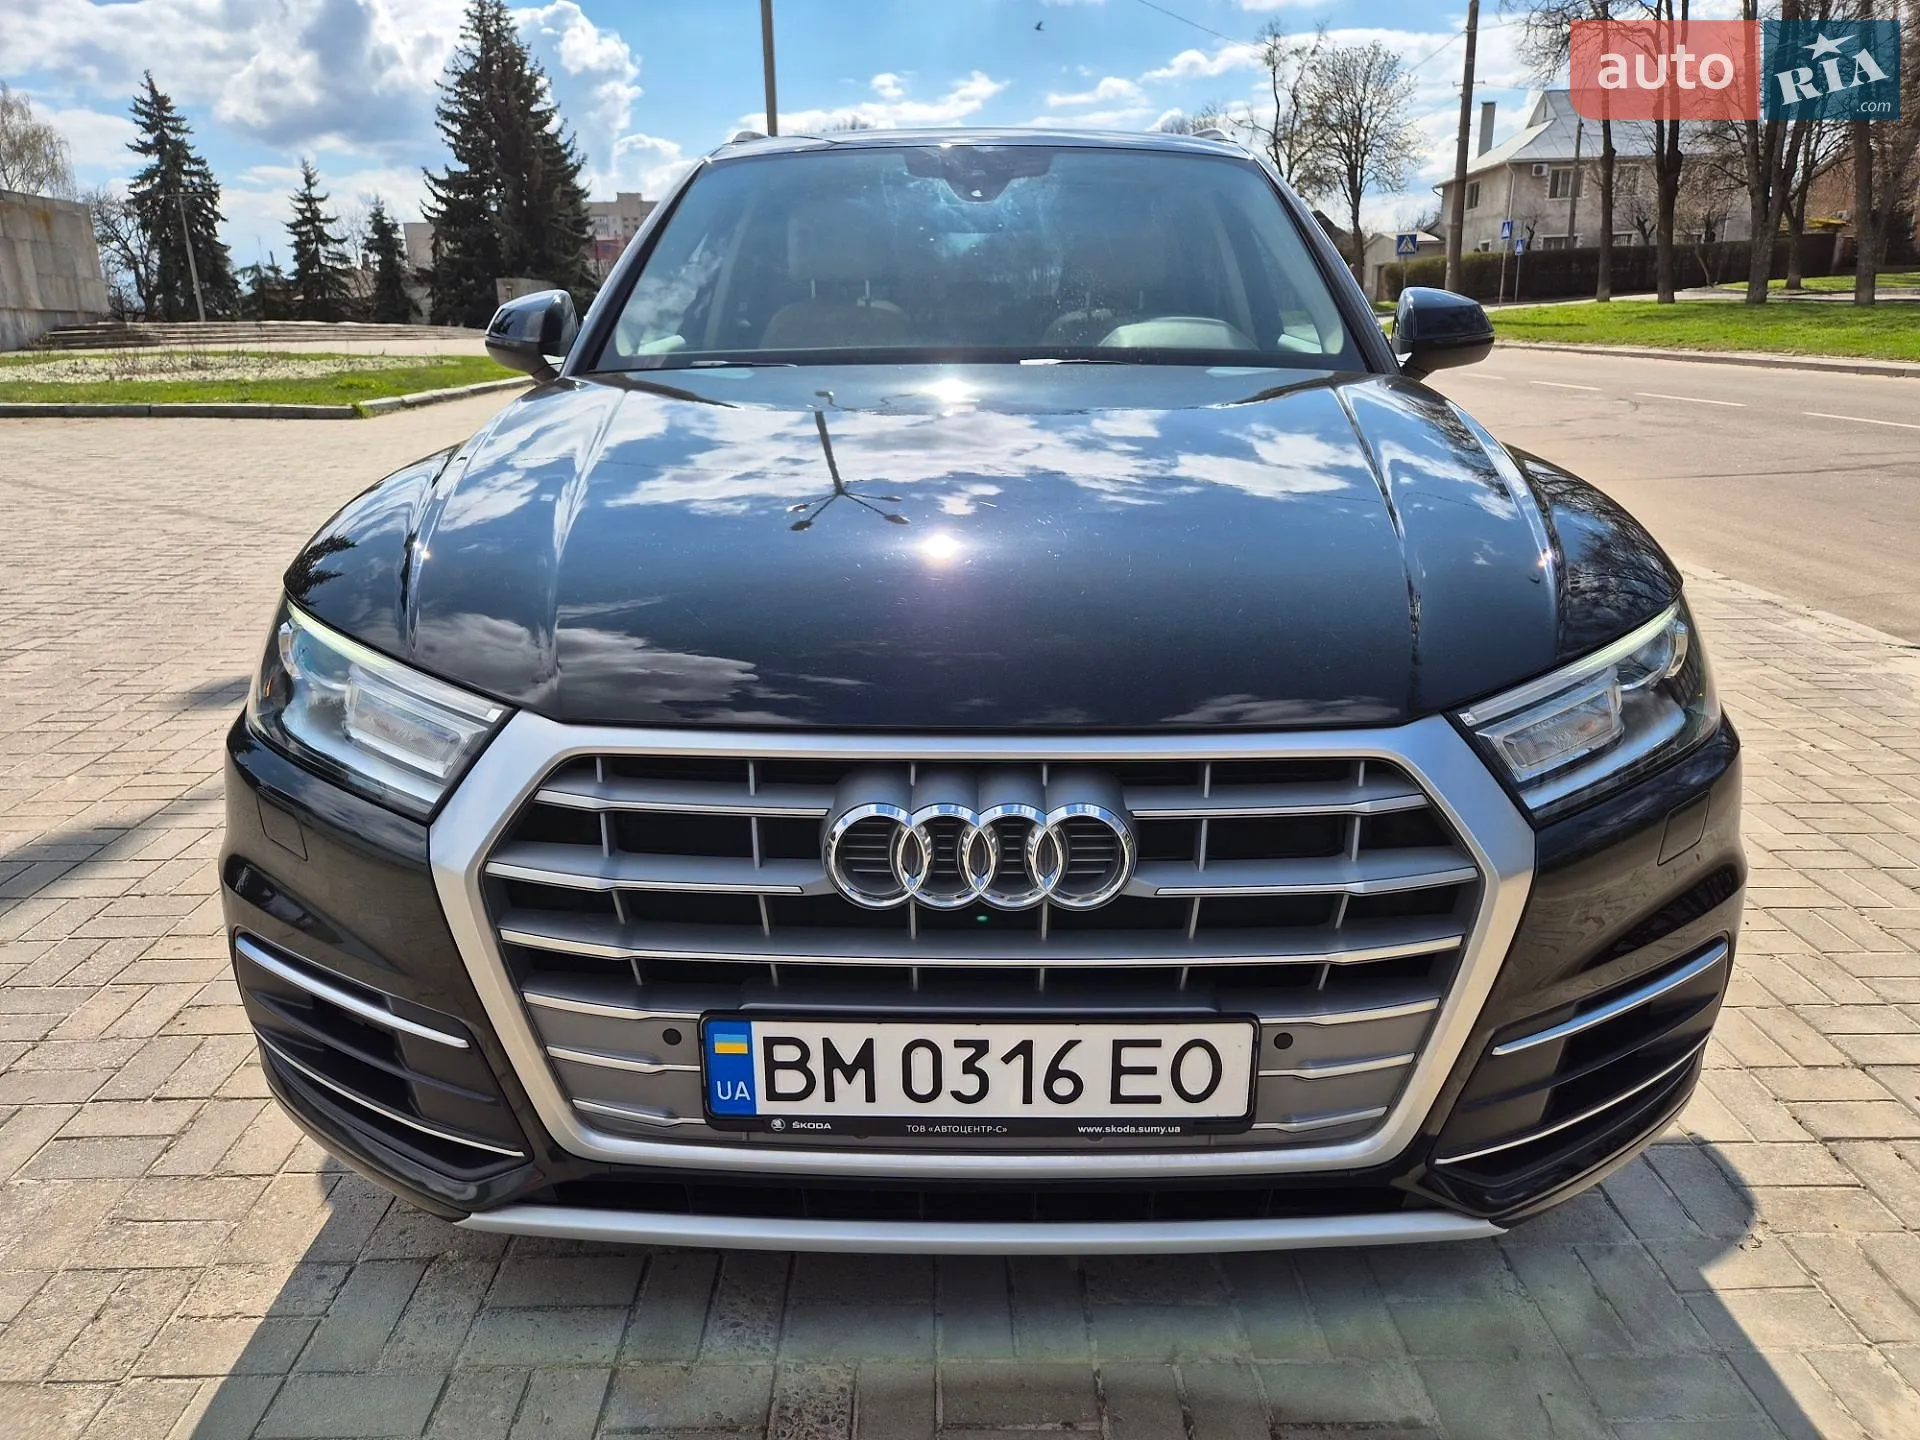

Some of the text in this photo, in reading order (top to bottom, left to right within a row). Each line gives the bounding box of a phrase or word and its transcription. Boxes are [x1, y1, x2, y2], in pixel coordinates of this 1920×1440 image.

[763, 1036, 1223, 1104] BM 0316 EO
[716, 1080, 751, 1101] UA
[906, 1124, 926, 1134] ТОВ
[1077, 1124, 1182, 1135] www.skoda.sumy.ua
